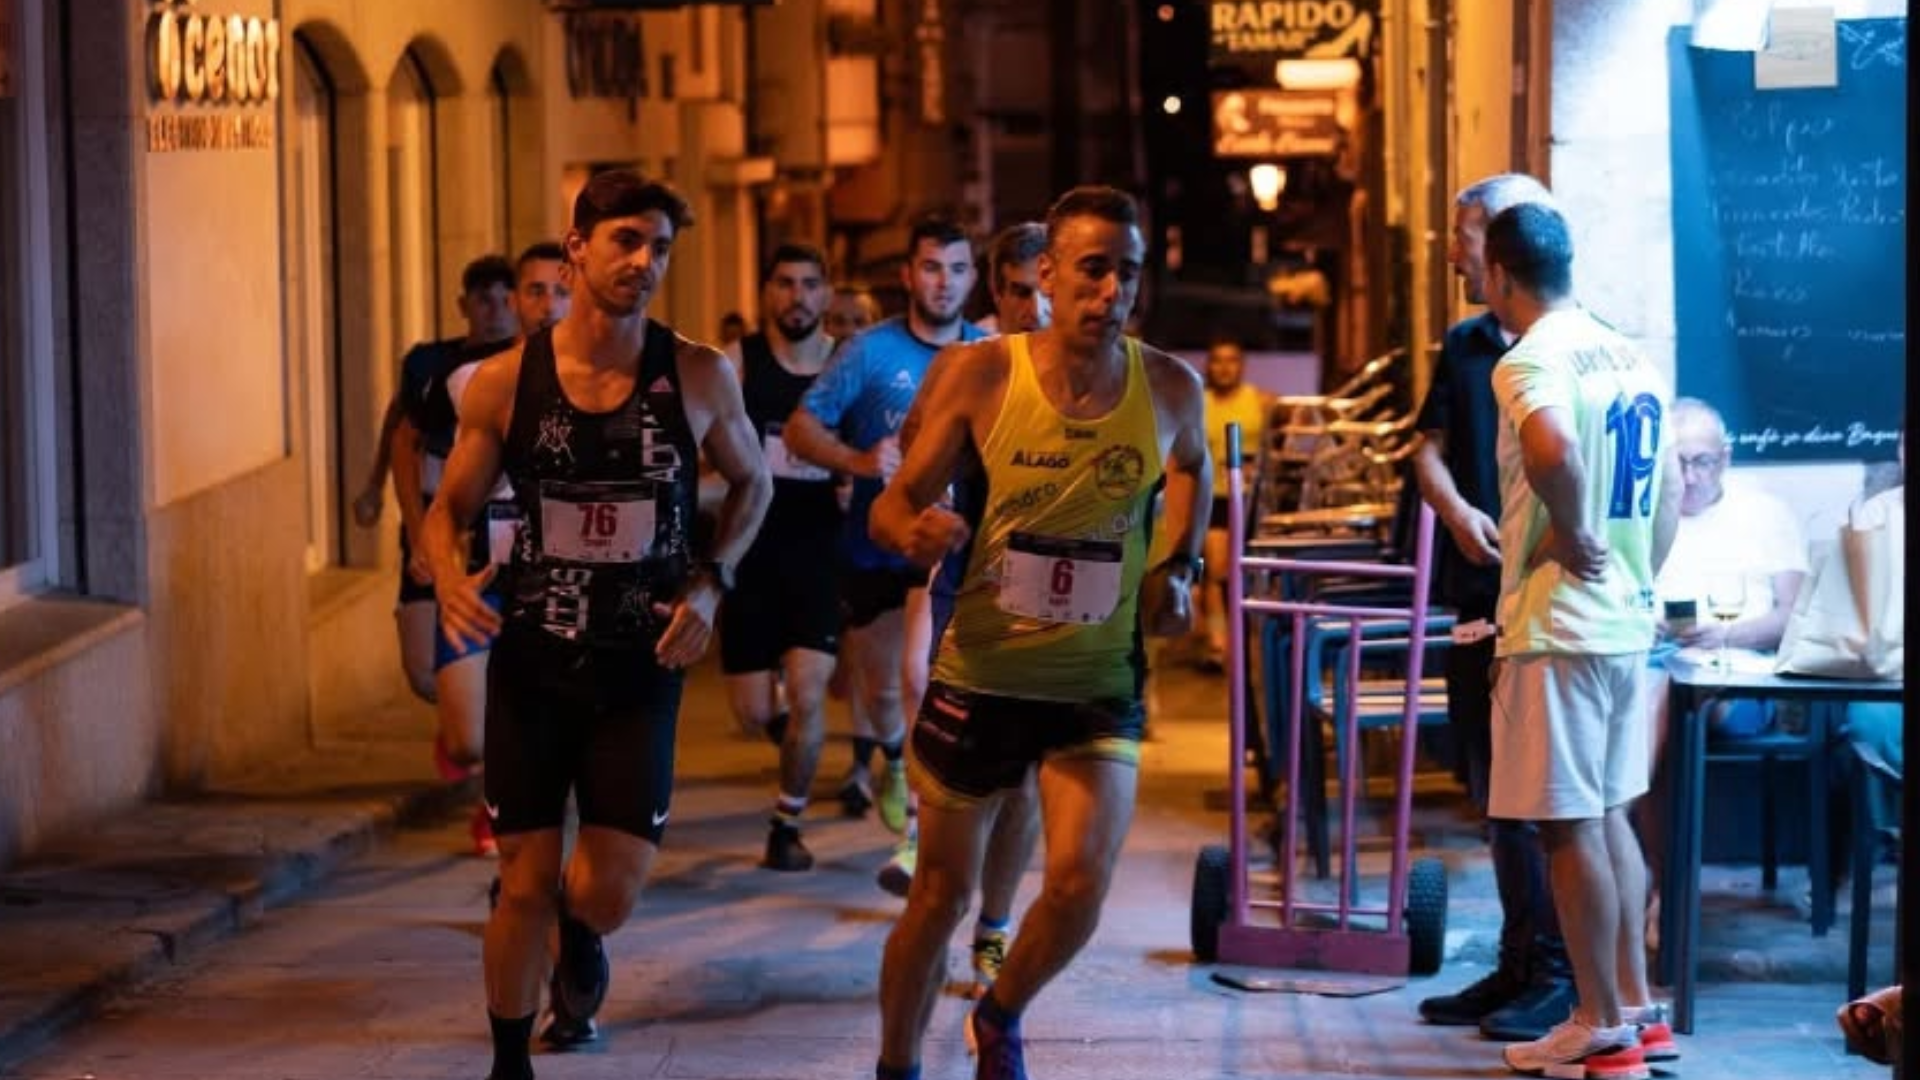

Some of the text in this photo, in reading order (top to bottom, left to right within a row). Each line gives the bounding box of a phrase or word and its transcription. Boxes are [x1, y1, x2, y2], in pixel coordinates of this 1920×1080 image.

[1211, 1, 1354, 30] RAPIDO
[1605, 391, 1662, 519] 19
[577, 502, 618, 538] 76
[1051, 559, 1075, 596] 6
